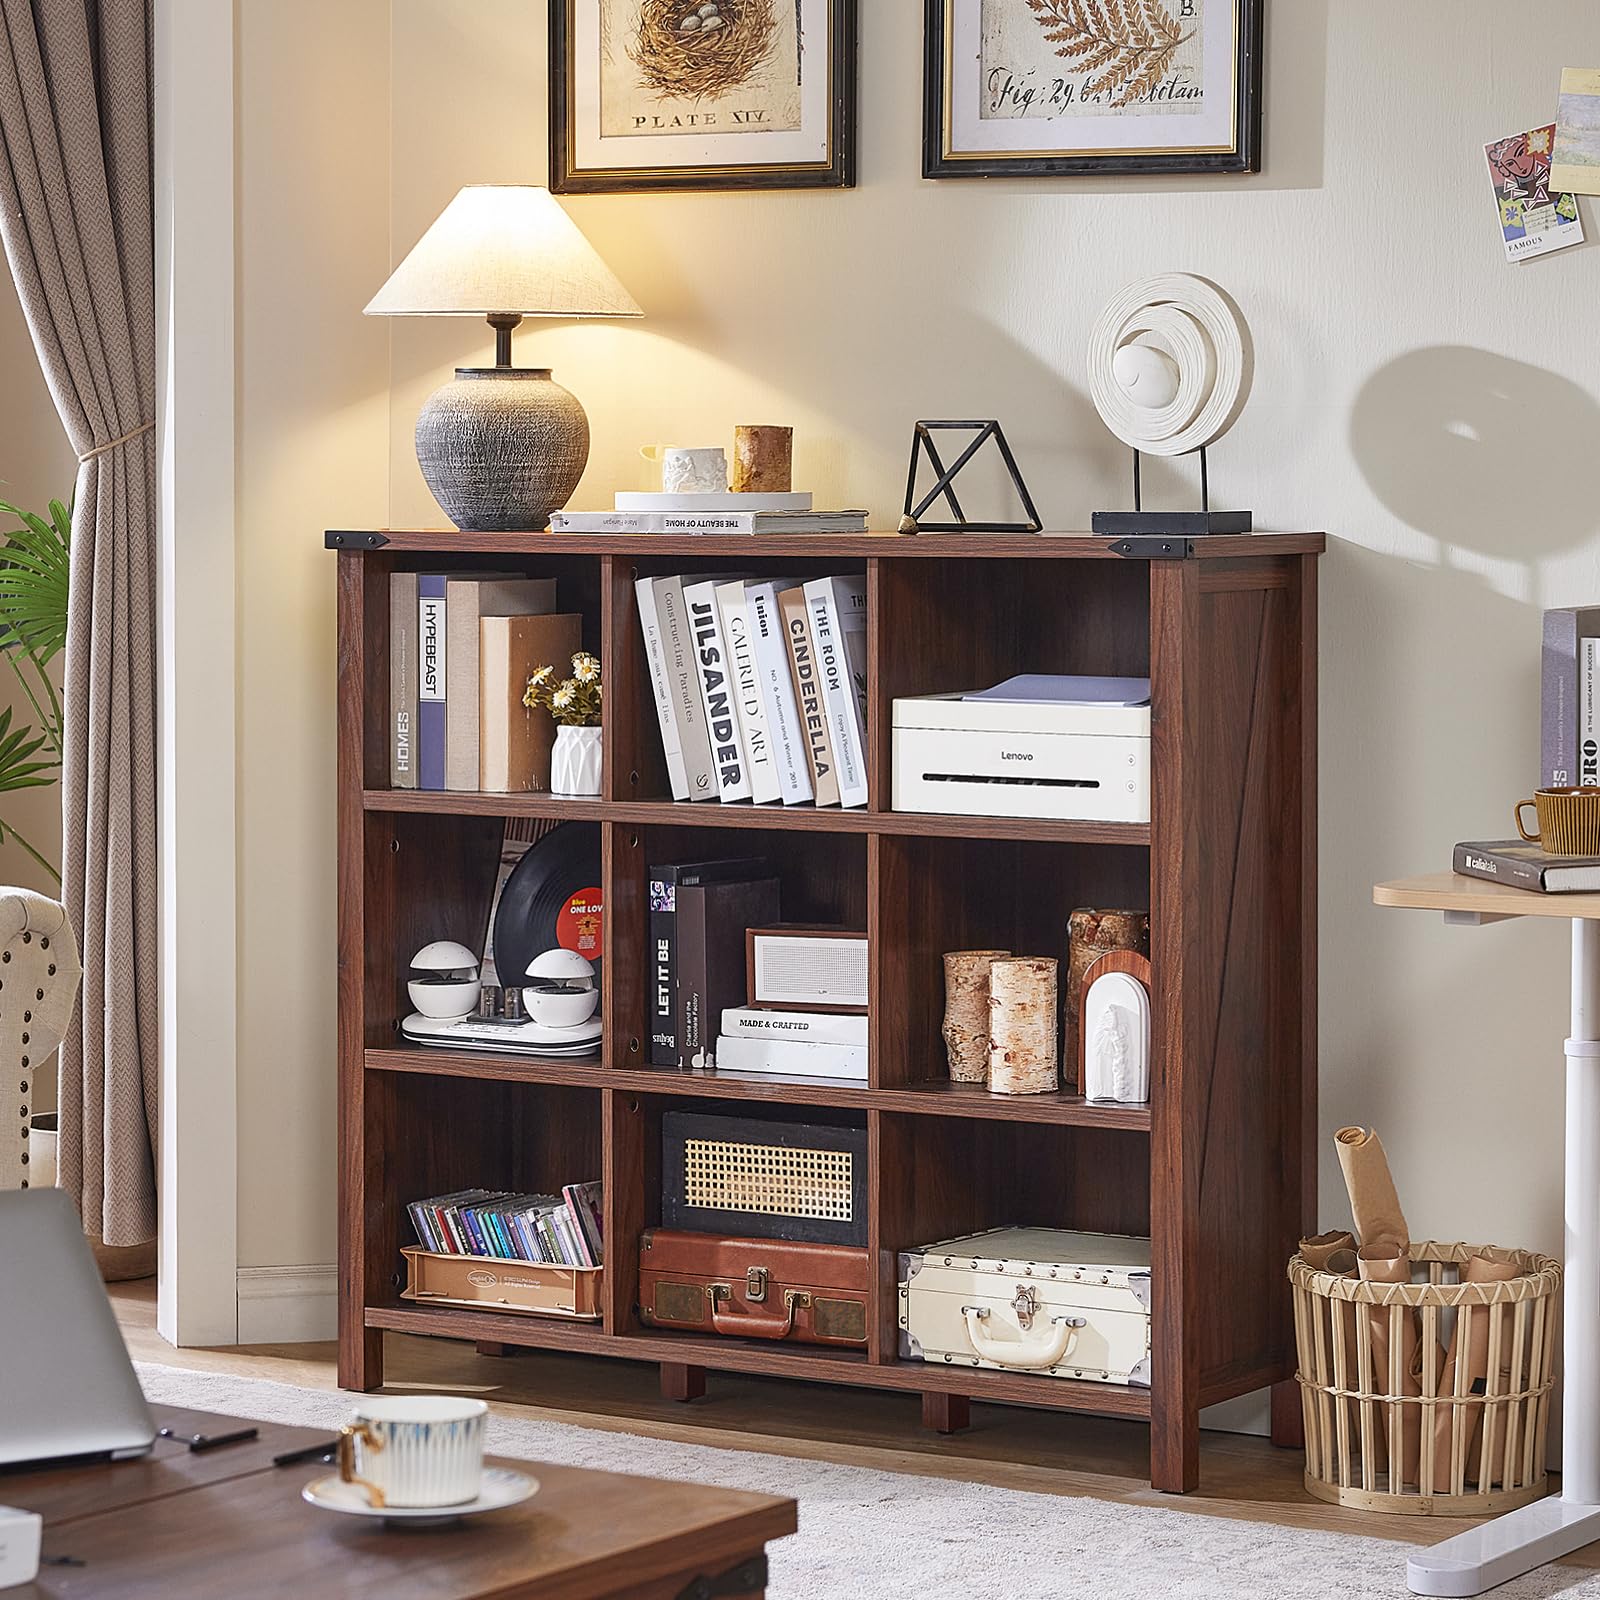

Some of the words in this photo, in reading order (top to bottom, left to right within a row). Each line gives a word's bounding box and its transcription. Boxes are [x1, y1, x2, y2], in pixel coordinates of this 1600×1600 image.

[632, 113, 717, 129] PLATE
[729, 110, 771, 124] XIV.
[1507, 237, 1543, 252] FAMOUS
[665, 519, 685, 528] HOME
[686, 519, 696, 528] OF
[696, 519, 725, 528] BEAUTY
[725, 519, 739, 528] THE
[850, 595, 867, 607] TH
[754, 595, 769, 638] Union
[815, 606, 831, 638] THE
[425, 604, 437, 695] HYPEBEAST
[664, 592, 685, 667] Constructing
[678, 672, 693, 723] Paradies
[770, 669, 777, 682] NO
[822, 645, 840, 691] ROOM
[1587, 672, 1593, 681] OF
[691, 602, 742, 788] JILSANDER
[731, 617, 757, 697] GALERIE
[749, 728, 768, 766] ART
[790, 618, 830, 779] CINDERELLA
[775, 694, 786, 724] Autumn
[397, 712, 409, 771] HOMES
[780, 725, 789, 740] and
[784, 743, 794, 768] Winter
[1001, 751, 1034, 761] Lenovo
[1583, 739, 1598, 787] ERO
[789, 772, 798, 789] 2018
[570, 906, 586, 914] ONE
[587, 905, 603, 913] LOV
[658, 939, 669, 961] BE
[658, 966, 669, 981] IT
[658, 983, 669, 1016] LET
[739, 1019, 764, 1028] MADE
[764, 1020, 771, 1028] &
[772, 1020, 809, 1030] CRAFTED
